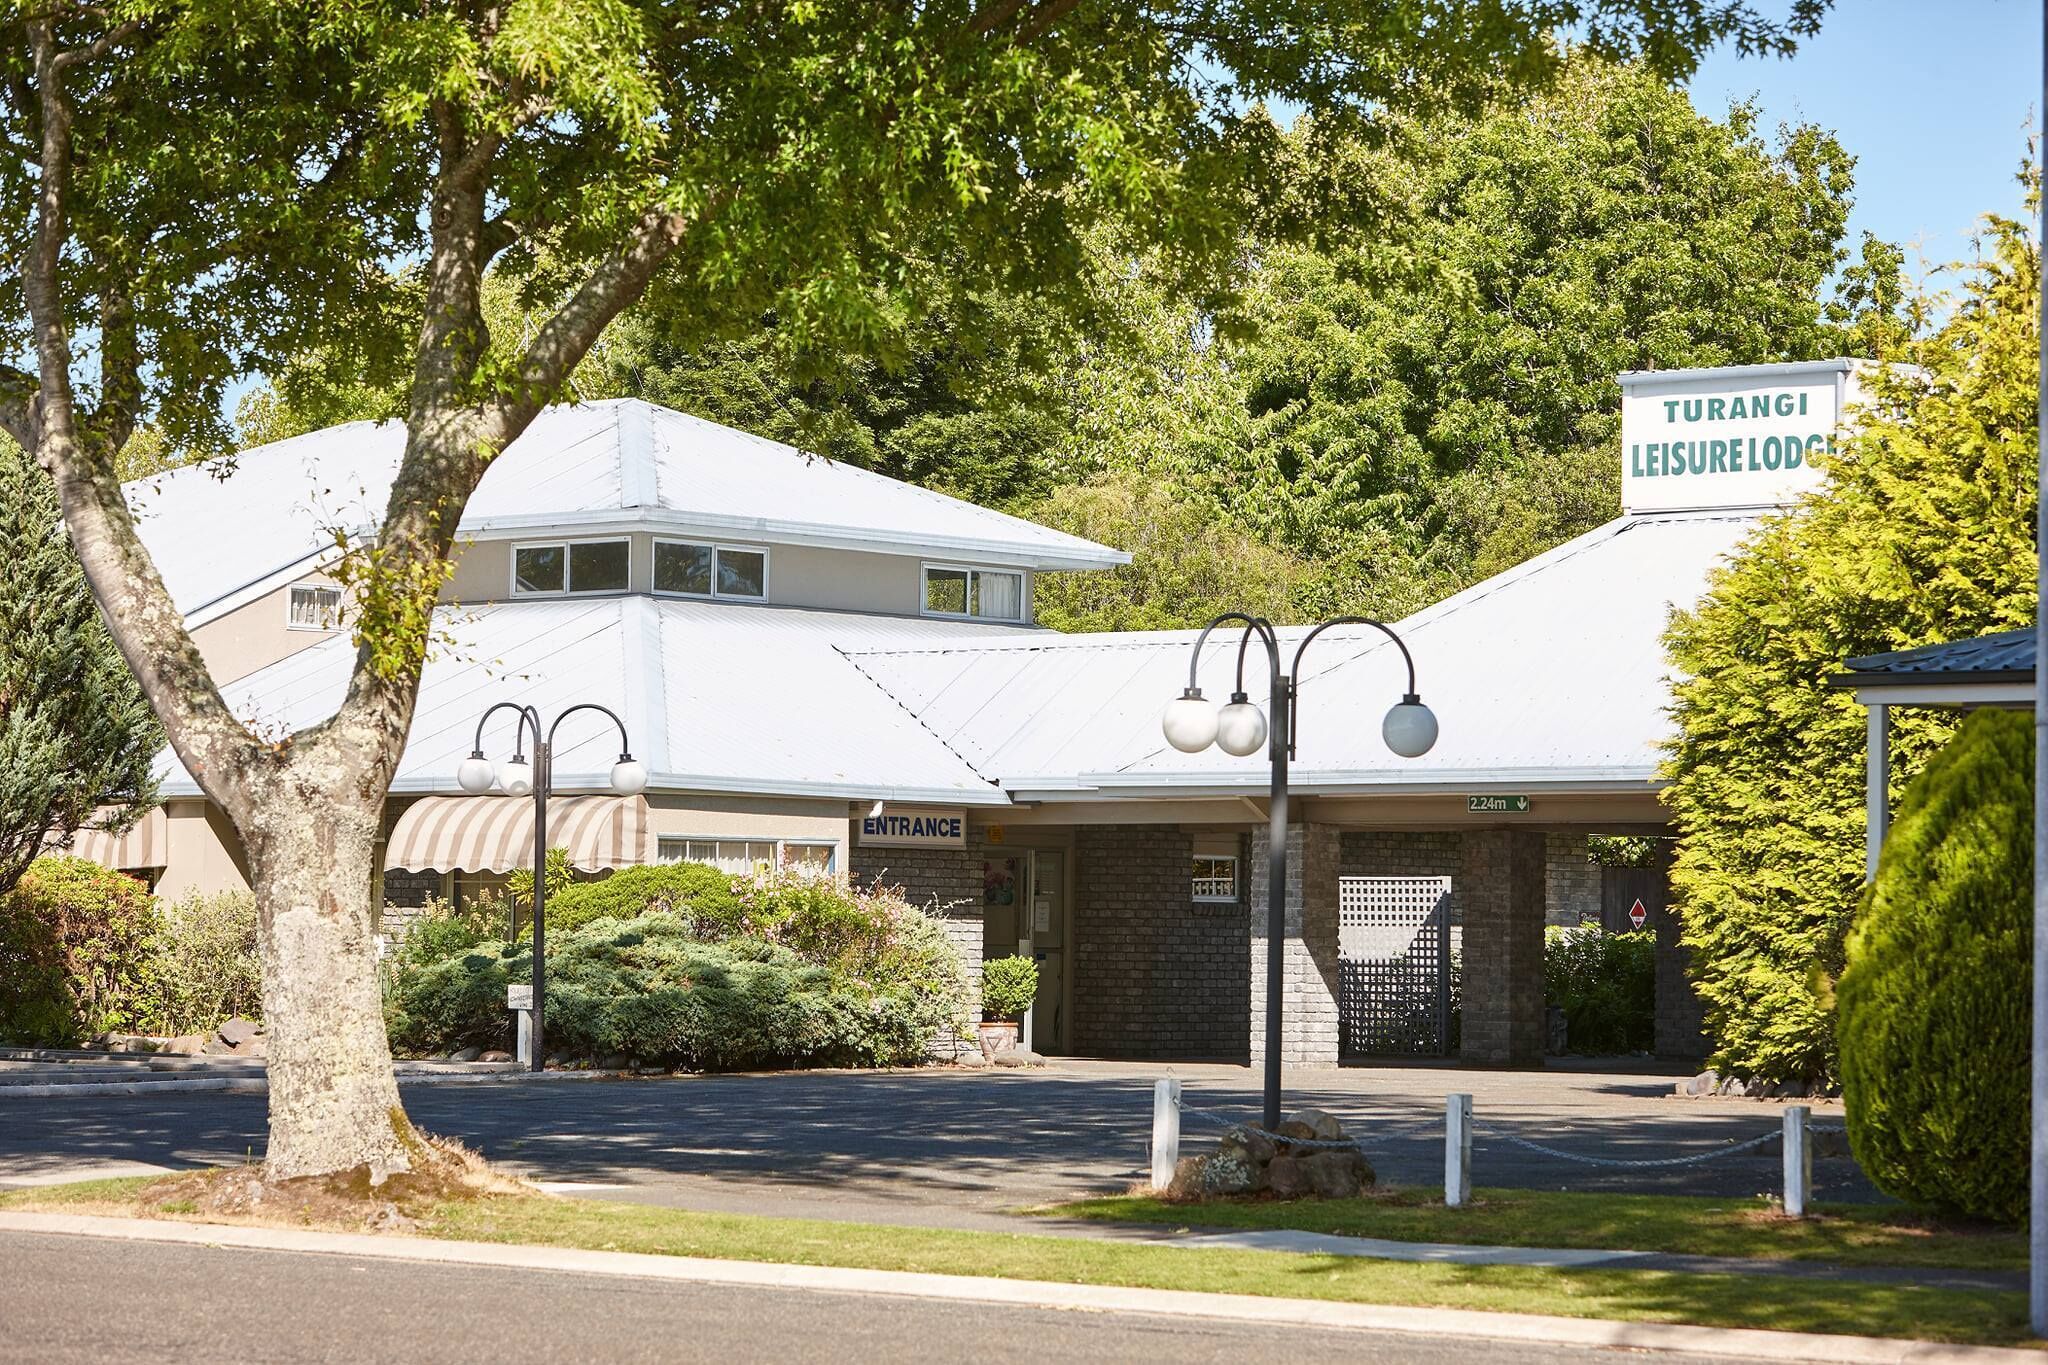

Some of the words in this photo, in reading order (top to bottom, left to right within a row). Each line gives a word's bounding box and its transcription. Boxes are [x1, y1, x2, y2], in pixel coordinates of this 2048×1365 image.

[1663, 393, 1807, 422] TURANGI
[1632, 438, 1743, 477] LEISURE
[1470, 797, 1506, 810] 2.24m
[863, 816, 961, 837] ENTRANCE
